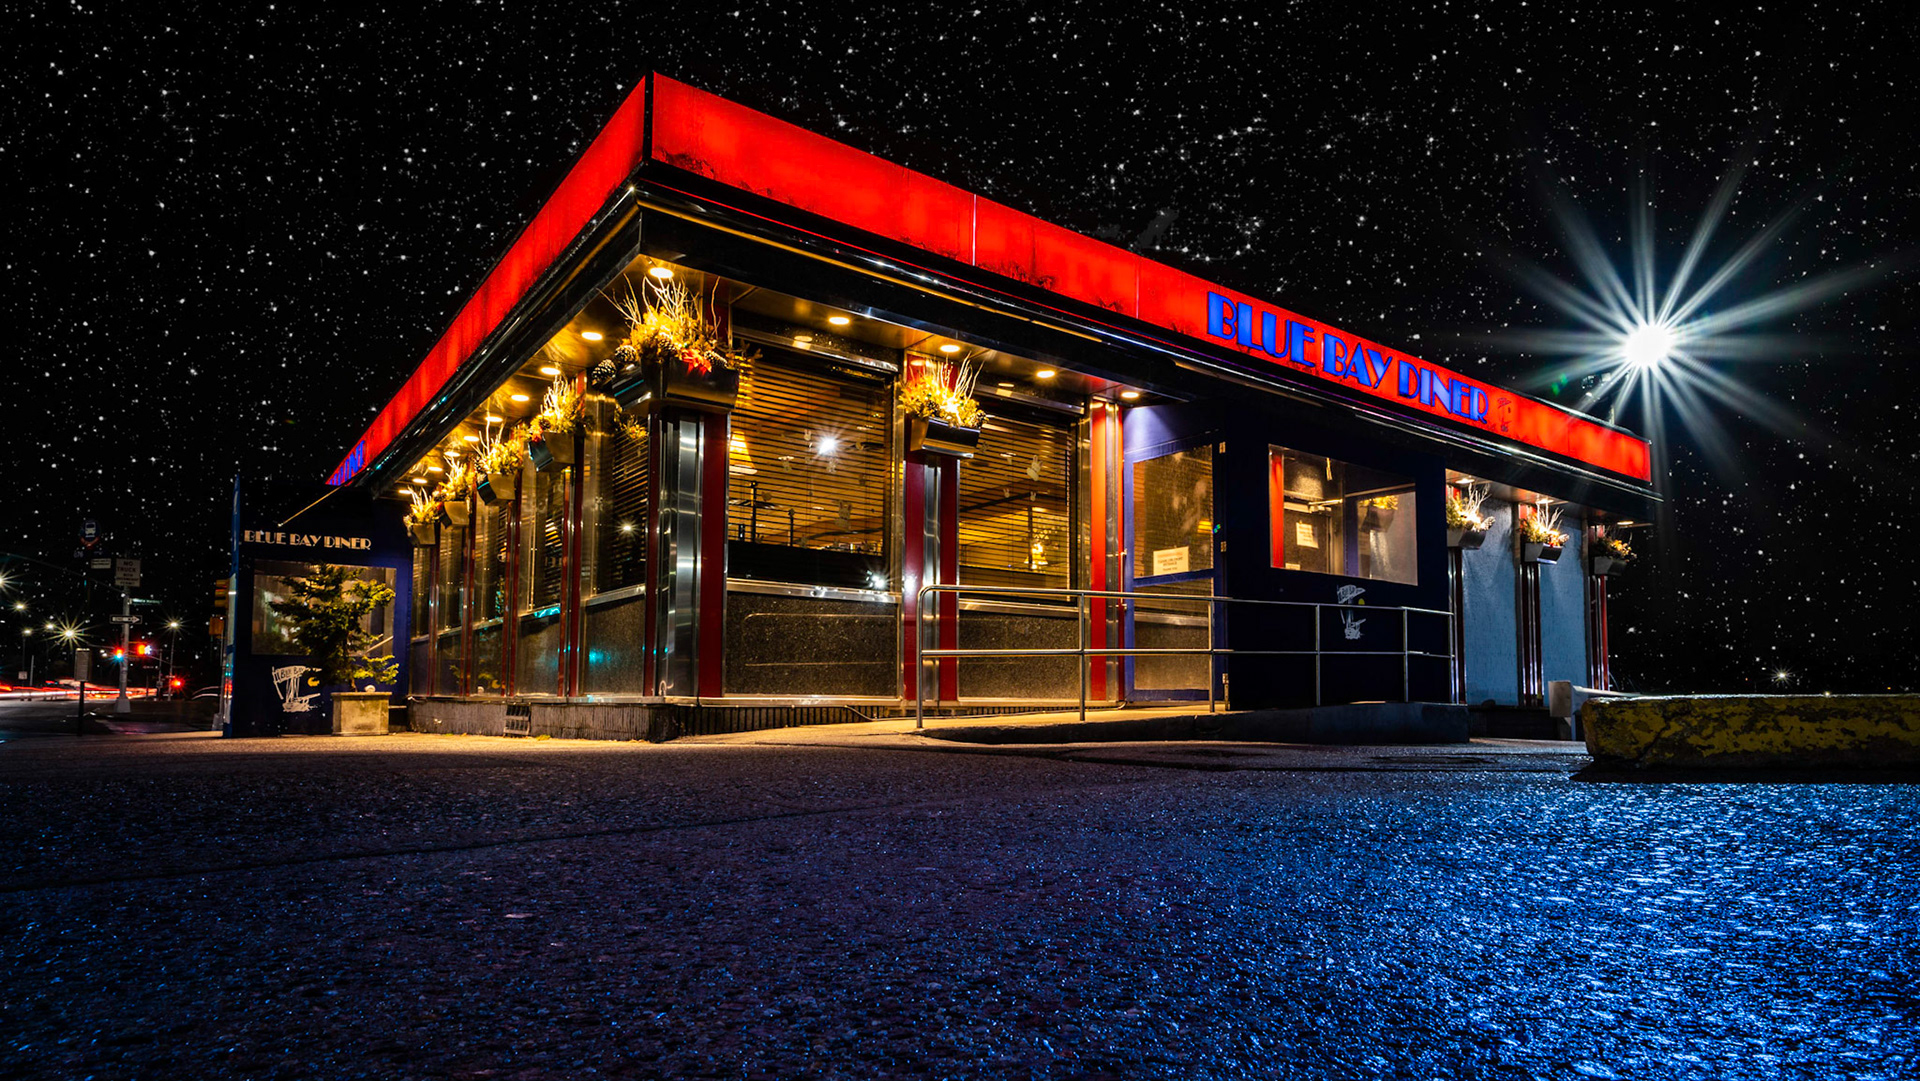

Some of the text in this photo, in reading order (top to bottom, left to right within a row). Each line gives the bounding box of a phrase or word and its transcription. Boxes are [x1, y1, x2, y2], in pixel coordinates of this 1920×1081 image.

[1207, 291, 1489, 424] BLUE BAY DINER
[244, 530, 372, 550] BLUE BAY DINER
